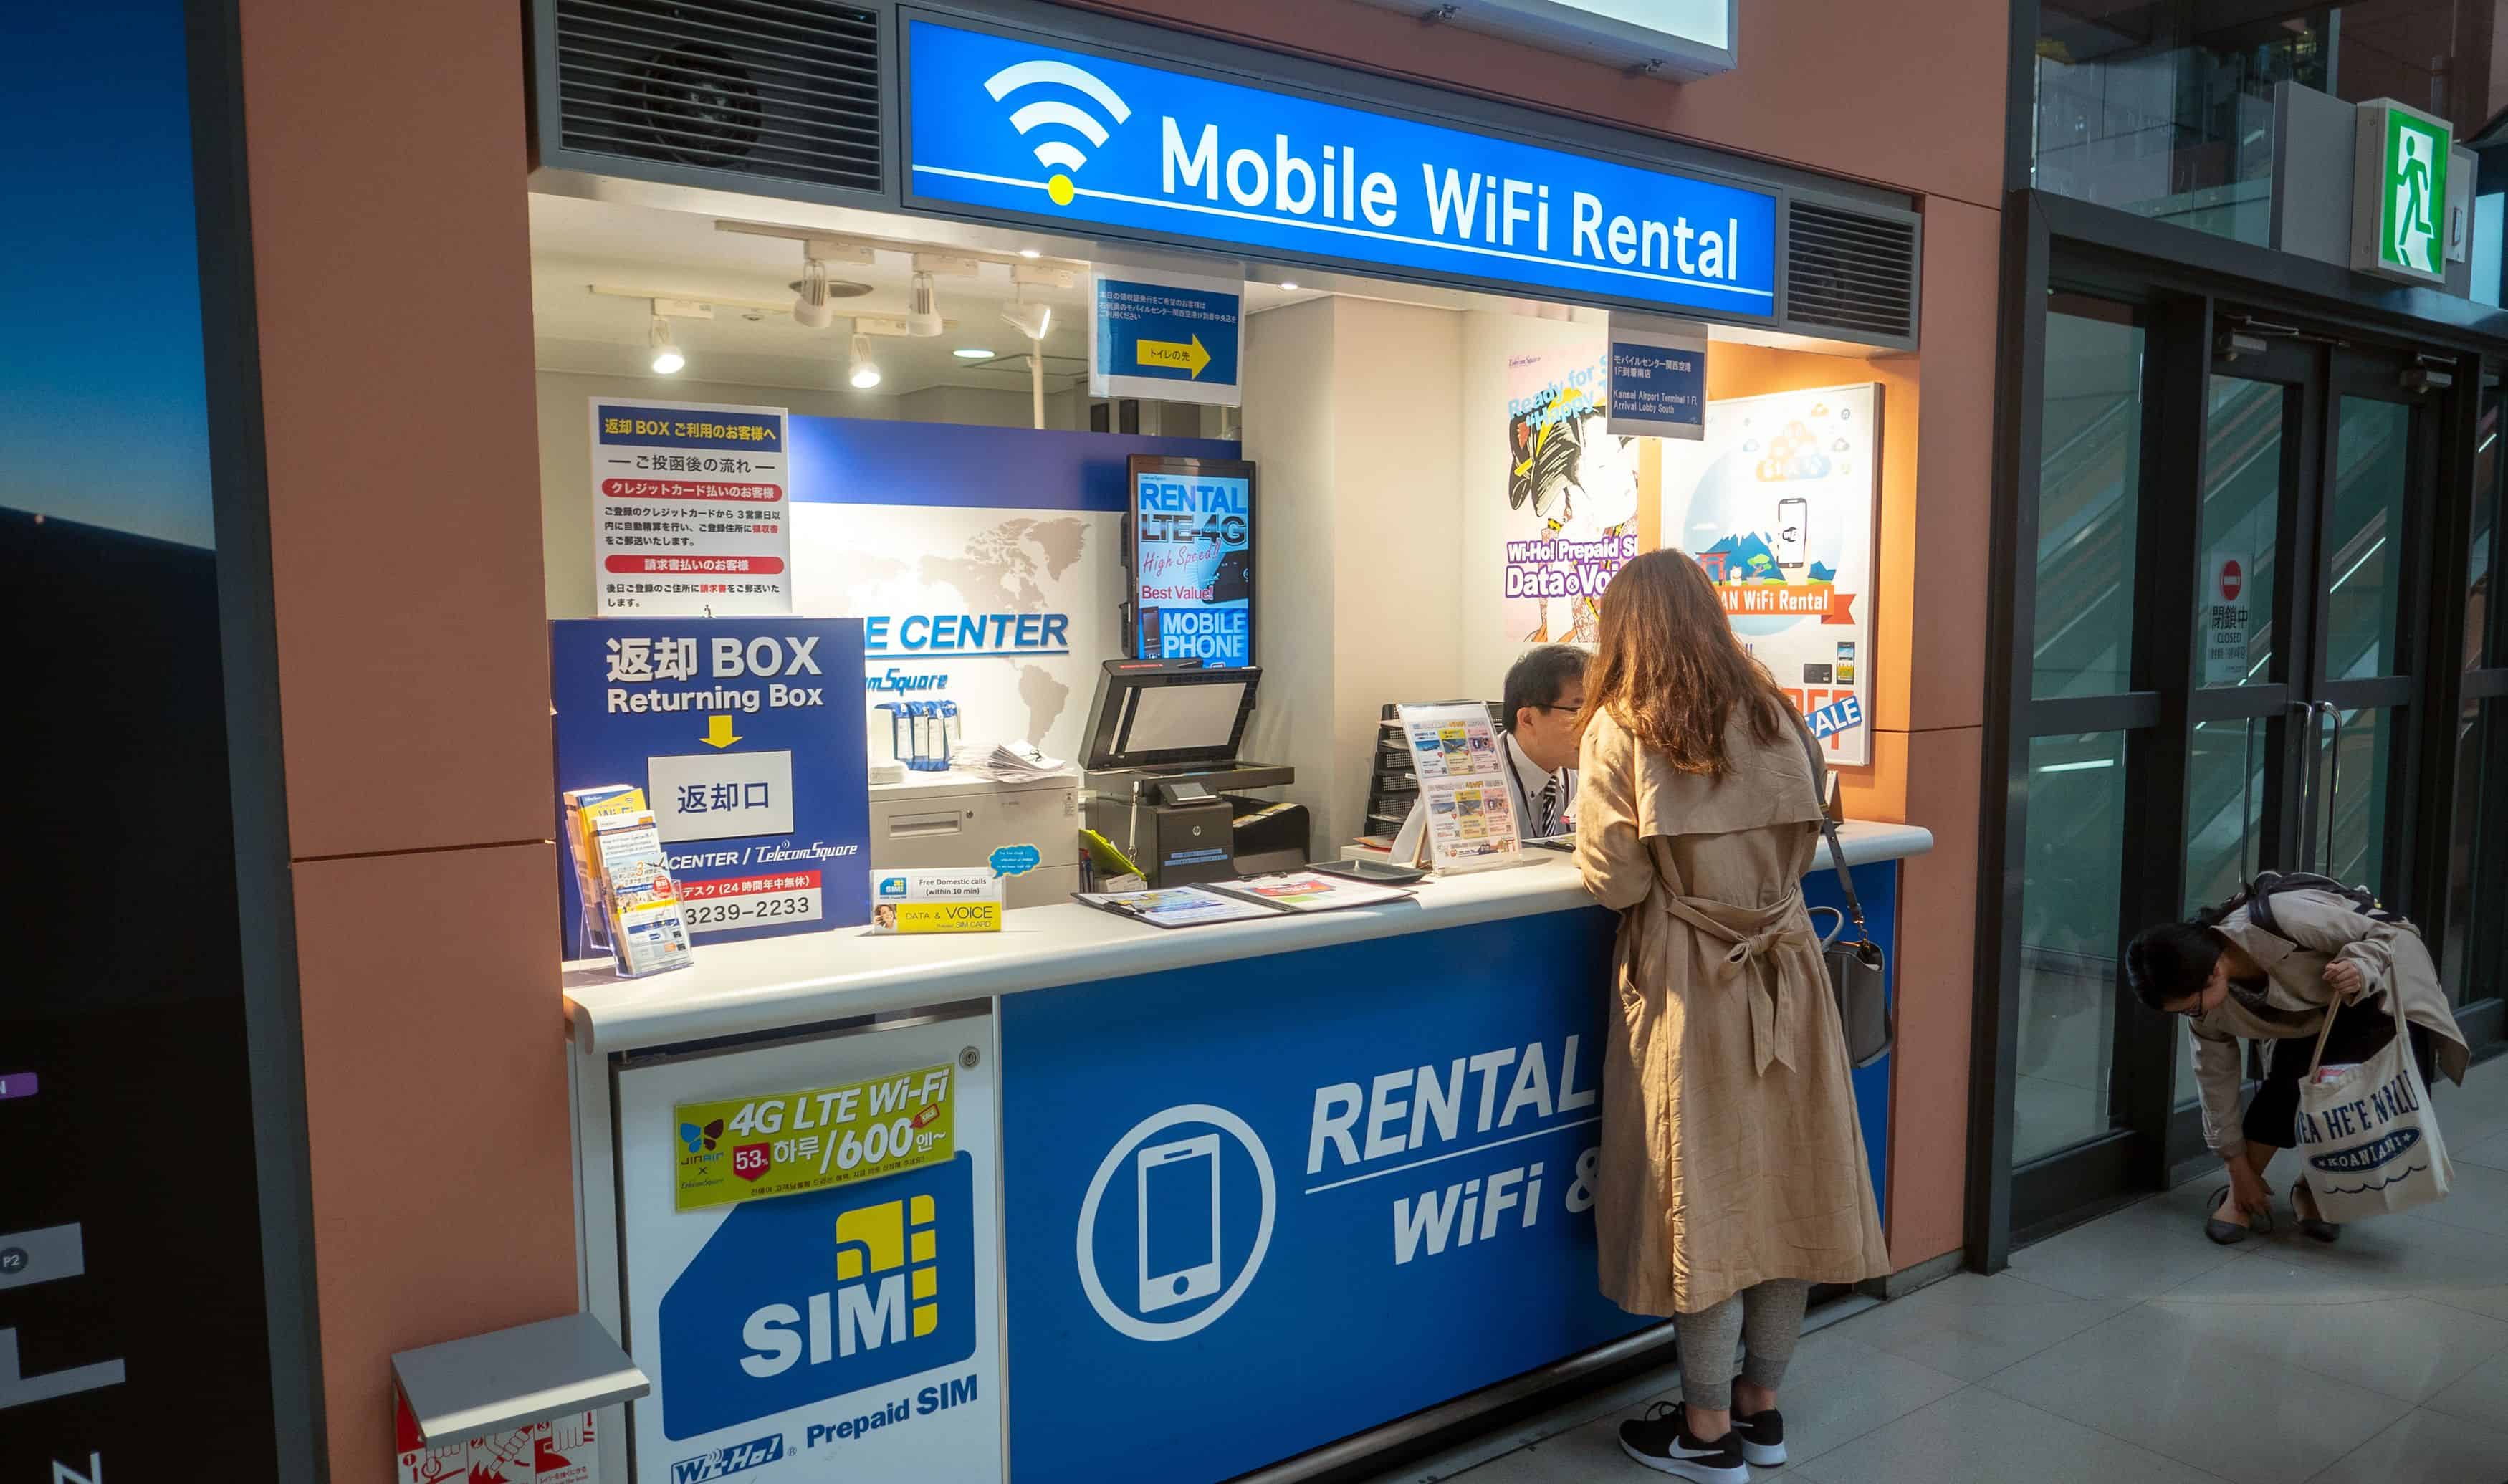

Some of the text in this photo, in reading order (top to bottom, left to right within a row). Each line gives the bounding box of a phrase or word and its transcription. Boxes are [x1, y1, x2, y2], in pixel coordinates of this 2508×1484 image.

[1162, 115, 1738, 280] Mobile WiFi Rental
[1150, 348, 1190, 362] トイレの先
[1507, 380, 1564, 419] Ready
[1567, 365, 1594, 389] for
[1613, 389, 1637, 400] Kansai
[1638, 391, 1660, 403] Airport
[1662, 393, 1685, 404] Terminal
[1613, 401, 1675, 413] Arrival Lobby South
[604, 418, 776, 441] 返却 BOX ご利用のお客様へ
[636, 454, 752, 474] ご投函後の流れ
[611, 482, 775, 499] クレジットカード払いのお客様
[1140, 482, 1248, 514] RENTAL
[604, 507, 734, 520] ご登録のクレジットカードから
[1141, 513, 1248, 546] LTE-4G
[1507, 540, 1556, 563] Wi-Ho!
[1558, 536, 1619, 562] Prepaid
[643, 557, 750, 573] 請求書払いのお客様
[1144, 551, 1174, 577] High
[607, 598, 641, 608] します。
[1141, 585, 1214, 600] Best Value!
[1743, 590, 1774, 611] WiFi
[1779, 590, 1828, 611] Rental
[1163, 613, 1246, 635] MOBILE
[2211, 605, 2248, 630] 閉鎖中
[900, 613, 1069, 651] CENTER
[2217, 632, 2242, 644] CLOSED
[606, 636, 822, 683] 返却 BOX
[1163, 636, 1245, 659] PHONE
[866, 668, 948, 696] mSquare
[607, 684, 823, 714] Returning Box
[676, 782, 770, 815] 返却口
[669, 851, 739, 871] CENTER
[755, 840, 858, 863] TelecomSquare
[682, 884, 715, 899] デスク
[925, 888, 952, 896] (within
[963, 887, 980, 896] min)
[905, 906, 993, 920] DATA & VOICE
[728, 1068, 952, 1137] 4G LTE Wi-Fi
[1307, 1034, 1597, 1175] RENTAL
[774, 1134, 820, 1164] 하루
[1393, 1161, 1545, 1265] WiFi
[2, 1255, 20, 1269] P2
[739, 1273, 906, 1378] SIM
[807, 1397, 909, 1449] Prepaid
[916, 1372, 978, 1416] SIM
